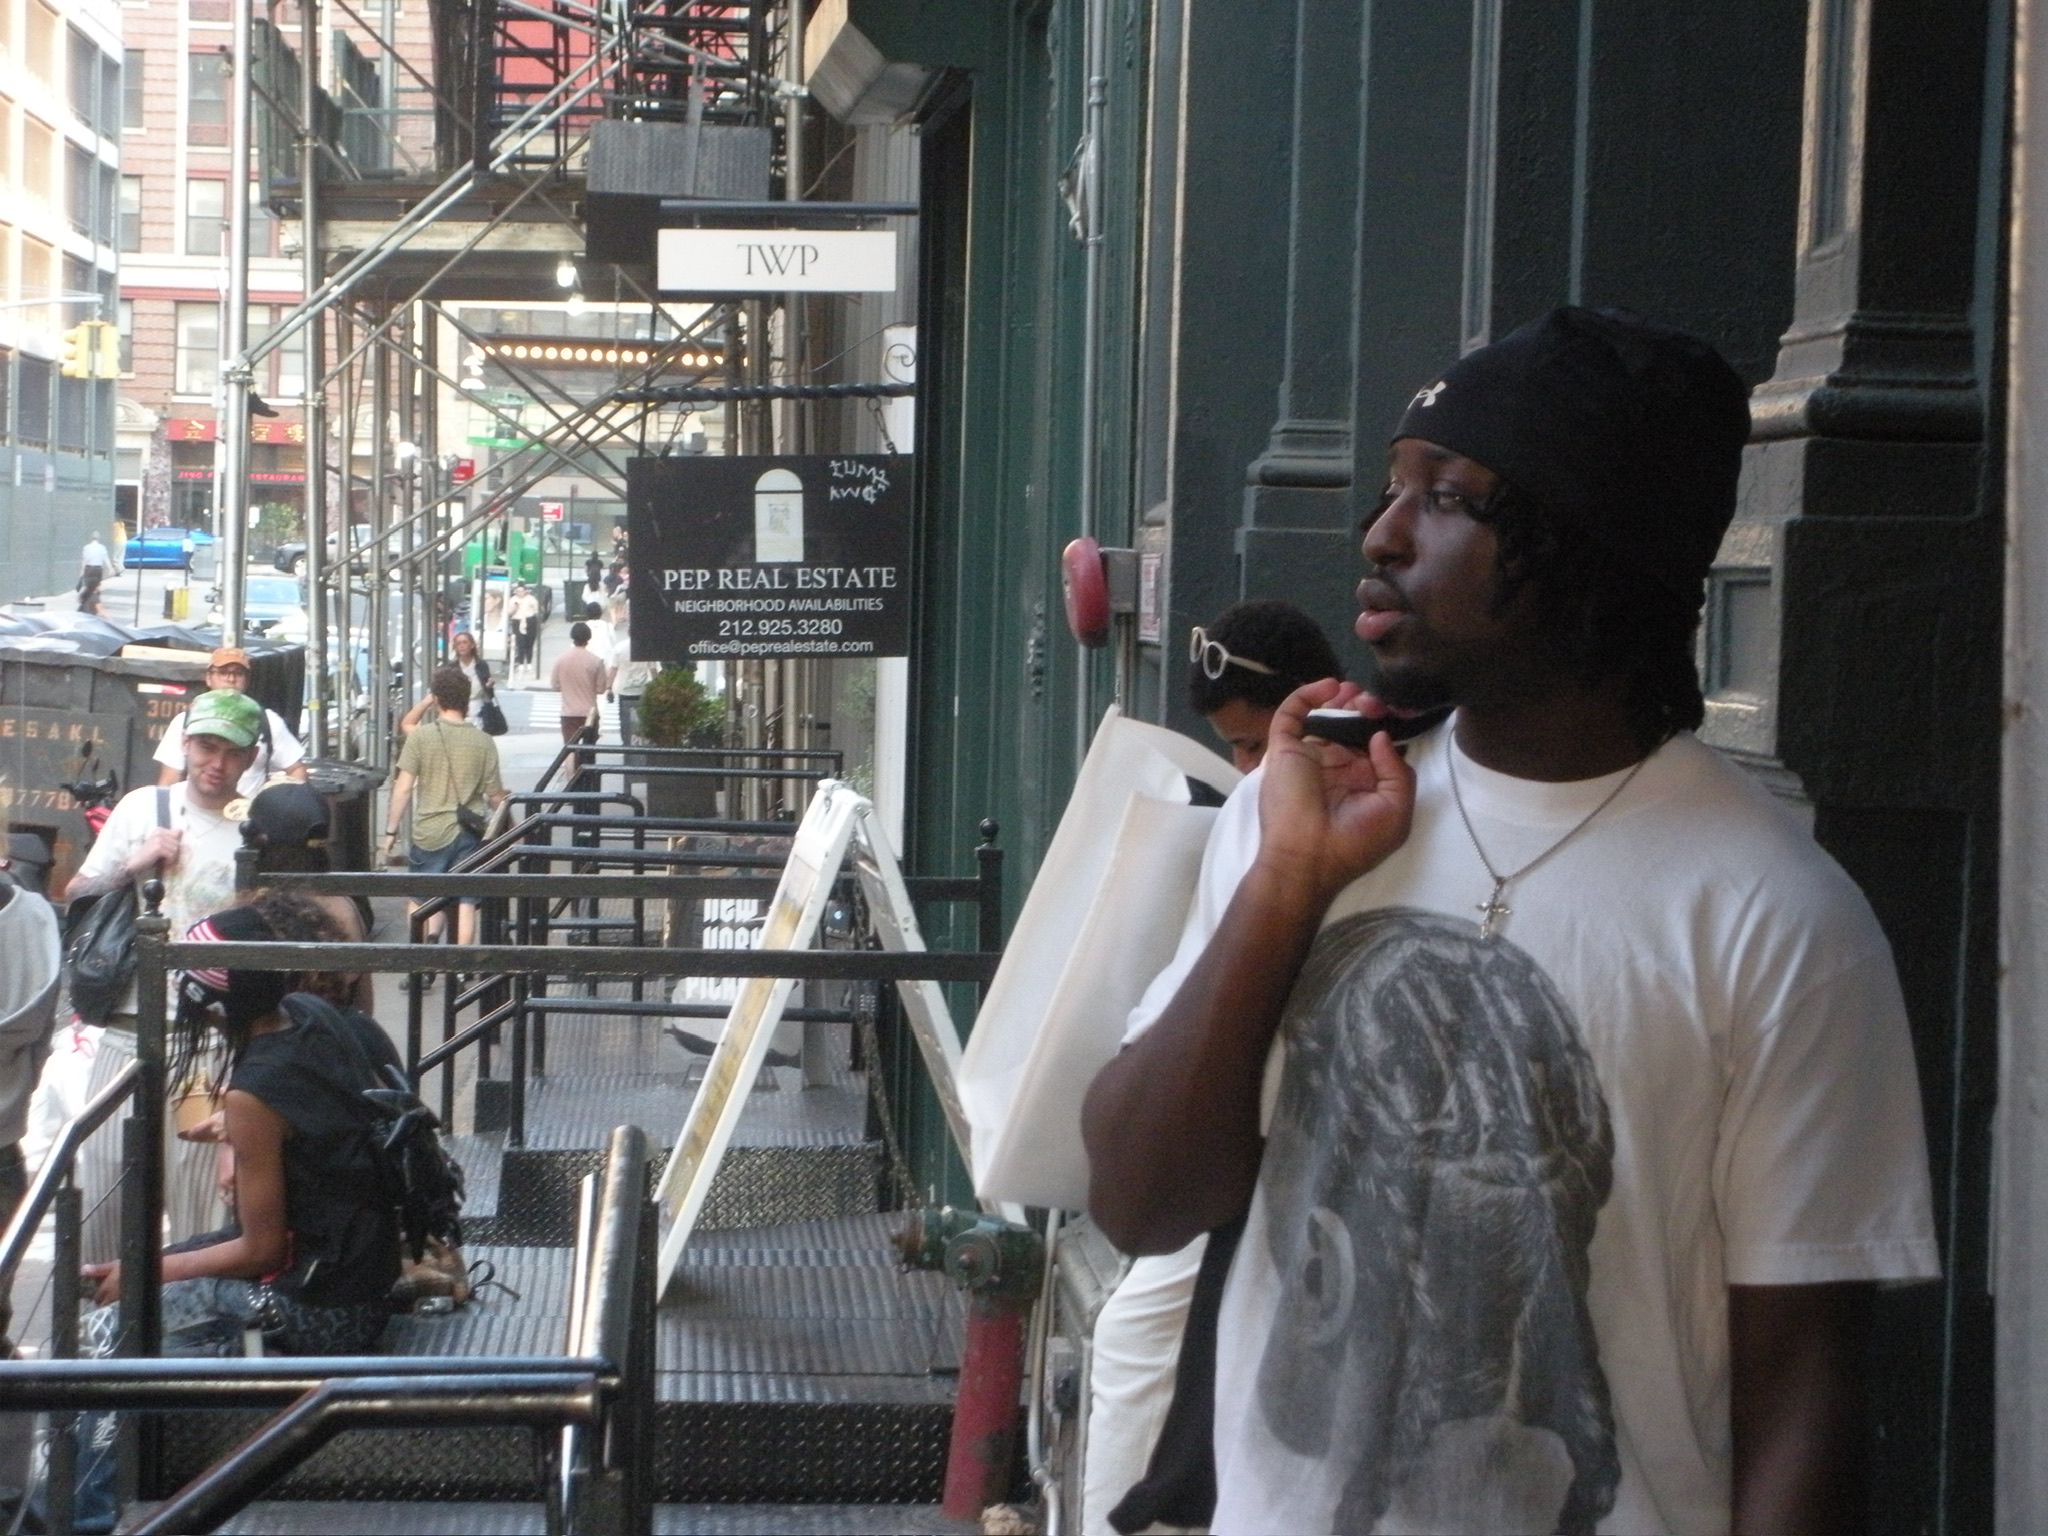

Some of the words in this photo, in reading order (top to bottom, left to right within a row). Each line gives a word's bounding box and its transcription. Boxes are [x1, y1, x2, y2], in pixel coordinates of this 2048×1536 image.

[737, 244, 819, 275] TWP
[663, 568, 711, 590] PEP
[717, 567, 788, 590] REAL
[796, 566, 897, 589] ESTATE
[674, 599, 785, 613] NEIGHBORHOOD
[788, 598, 884, 612] AVAILABILITIES
[719, 619, 843, 636] 212.925.3280
[688, 639, 874, 656] office@peprealestate.com
